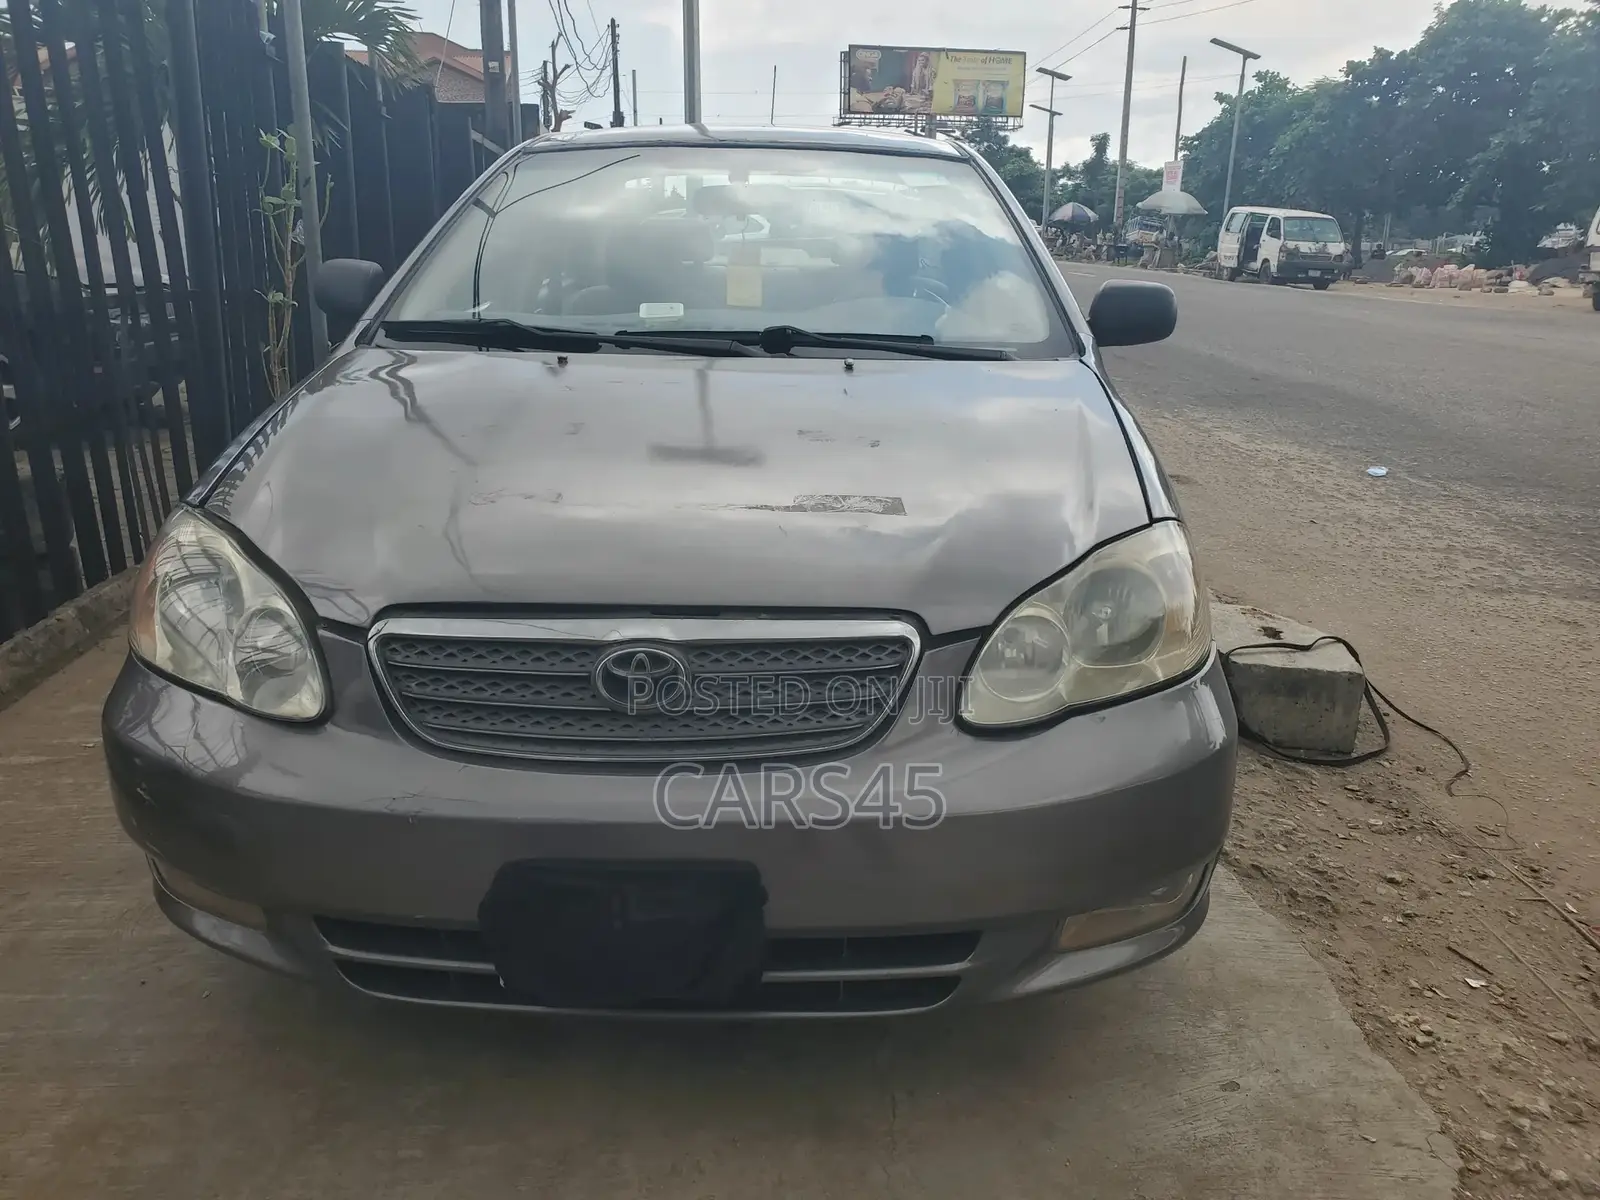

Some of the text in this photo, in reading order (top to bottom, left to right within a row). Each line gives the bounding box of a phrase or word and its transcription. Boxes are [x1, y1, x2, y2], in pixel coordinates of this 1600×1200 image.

[950, 55, 962, 63] The
[980, 56, 987, 65] of
[988, 56, 1013, 65] HOME
